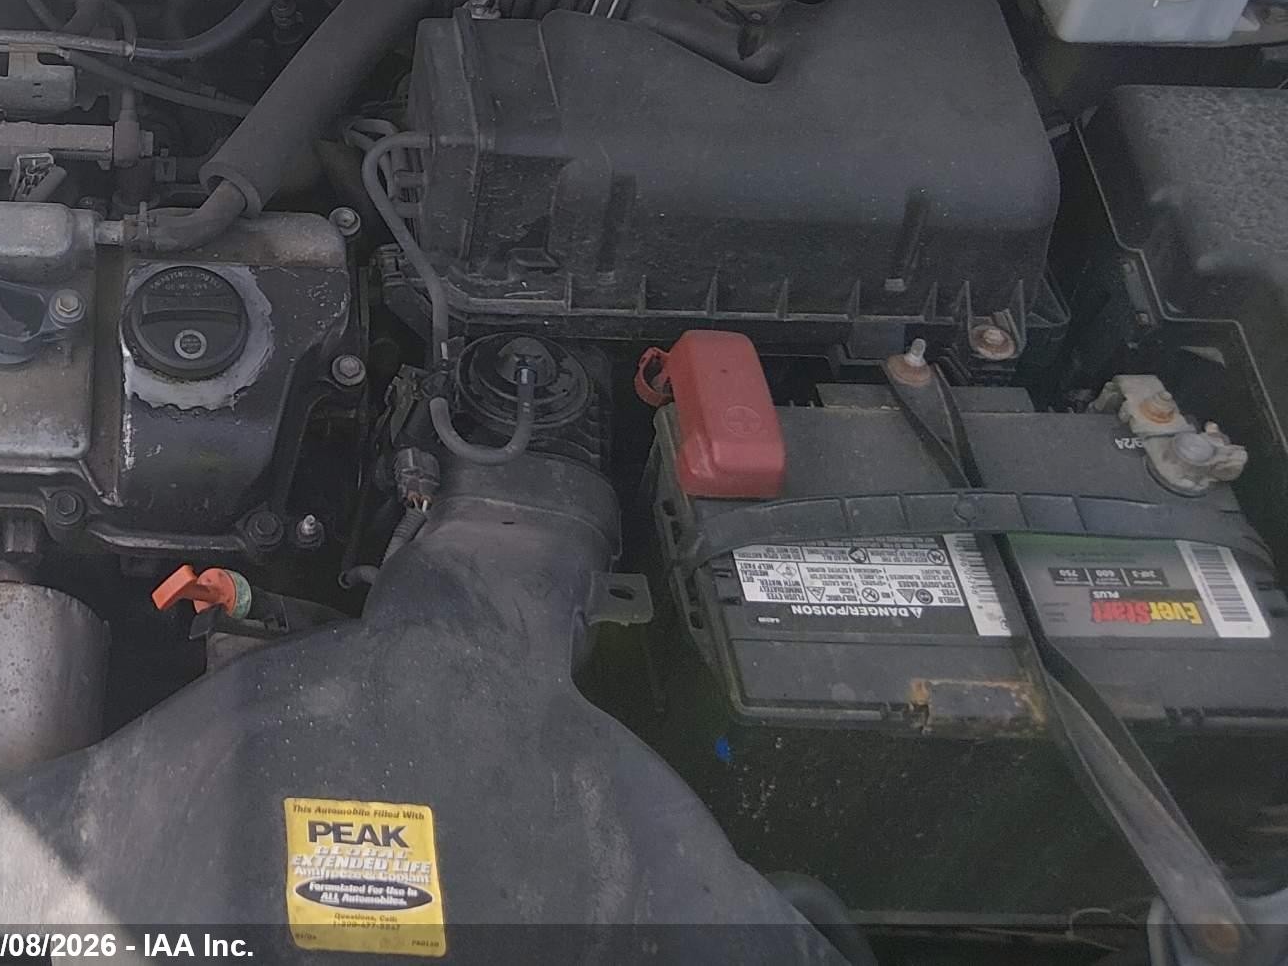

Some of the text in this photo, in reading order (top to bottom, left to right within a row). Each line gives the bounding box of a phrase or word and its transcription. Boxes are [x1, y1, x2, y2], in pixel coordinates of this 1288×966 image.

[1059, 569, 1079, 577] 750
[1095, 569, 1115, 577] 600
[1092, 591, 1119, 599] PLUS
[790, 605, 909, 617] DANGER/POISON
[1091, 601, 1204, 624] EverStart
[293, 805, 425, 820] This Automobile Filled With
[308, 820, 409, 848] PEAK
[292, 855, 431, 875] EXTENDED LIFE
[309, 882, 418, 897] Formulated For Use In
[320, 892, 339, 903] ALL
